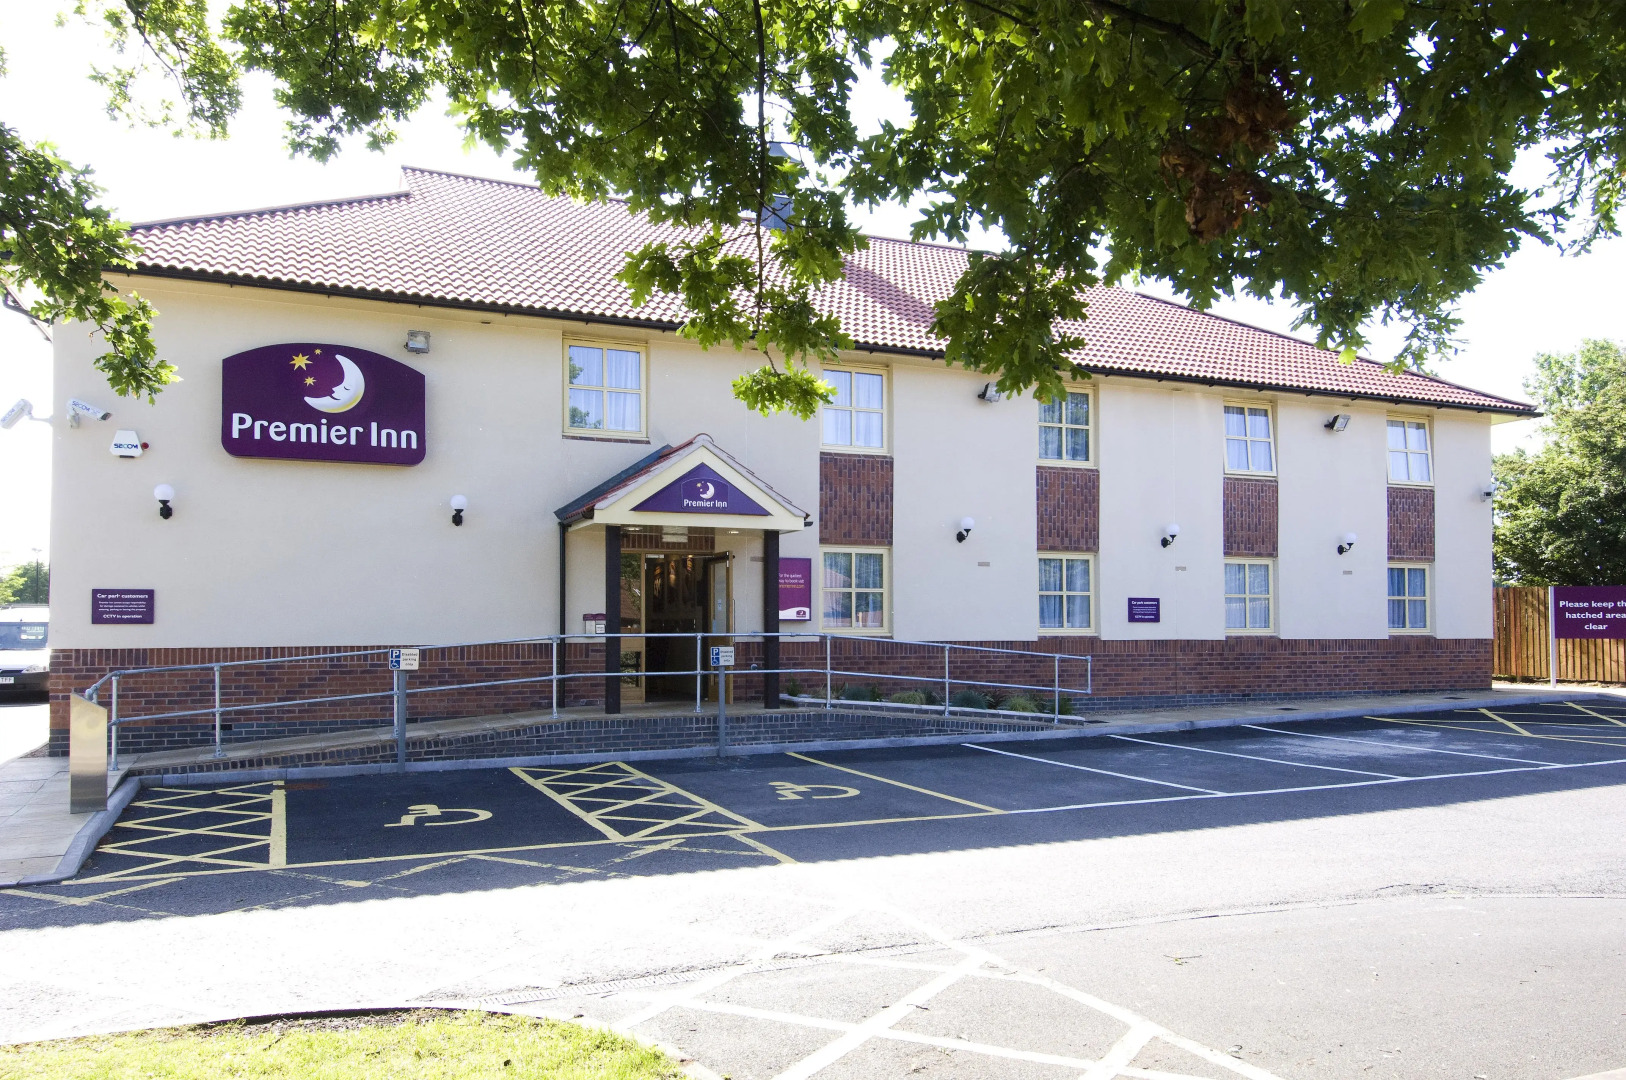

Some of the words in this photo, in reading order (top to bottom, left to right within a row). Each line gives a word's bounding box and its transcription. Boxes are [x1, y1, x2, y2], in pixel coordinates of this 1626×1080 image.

[231, 412, 364, 445] Premier
[370, 421, 418, 449] Inn
[683, 498, 714, 508] Premier
[715, 499, 728, 508] Inn
[1559, 600, 1589, 608] Please
[1591, 600, 1615, 609] keep
[393, 650, 400, 658] P
